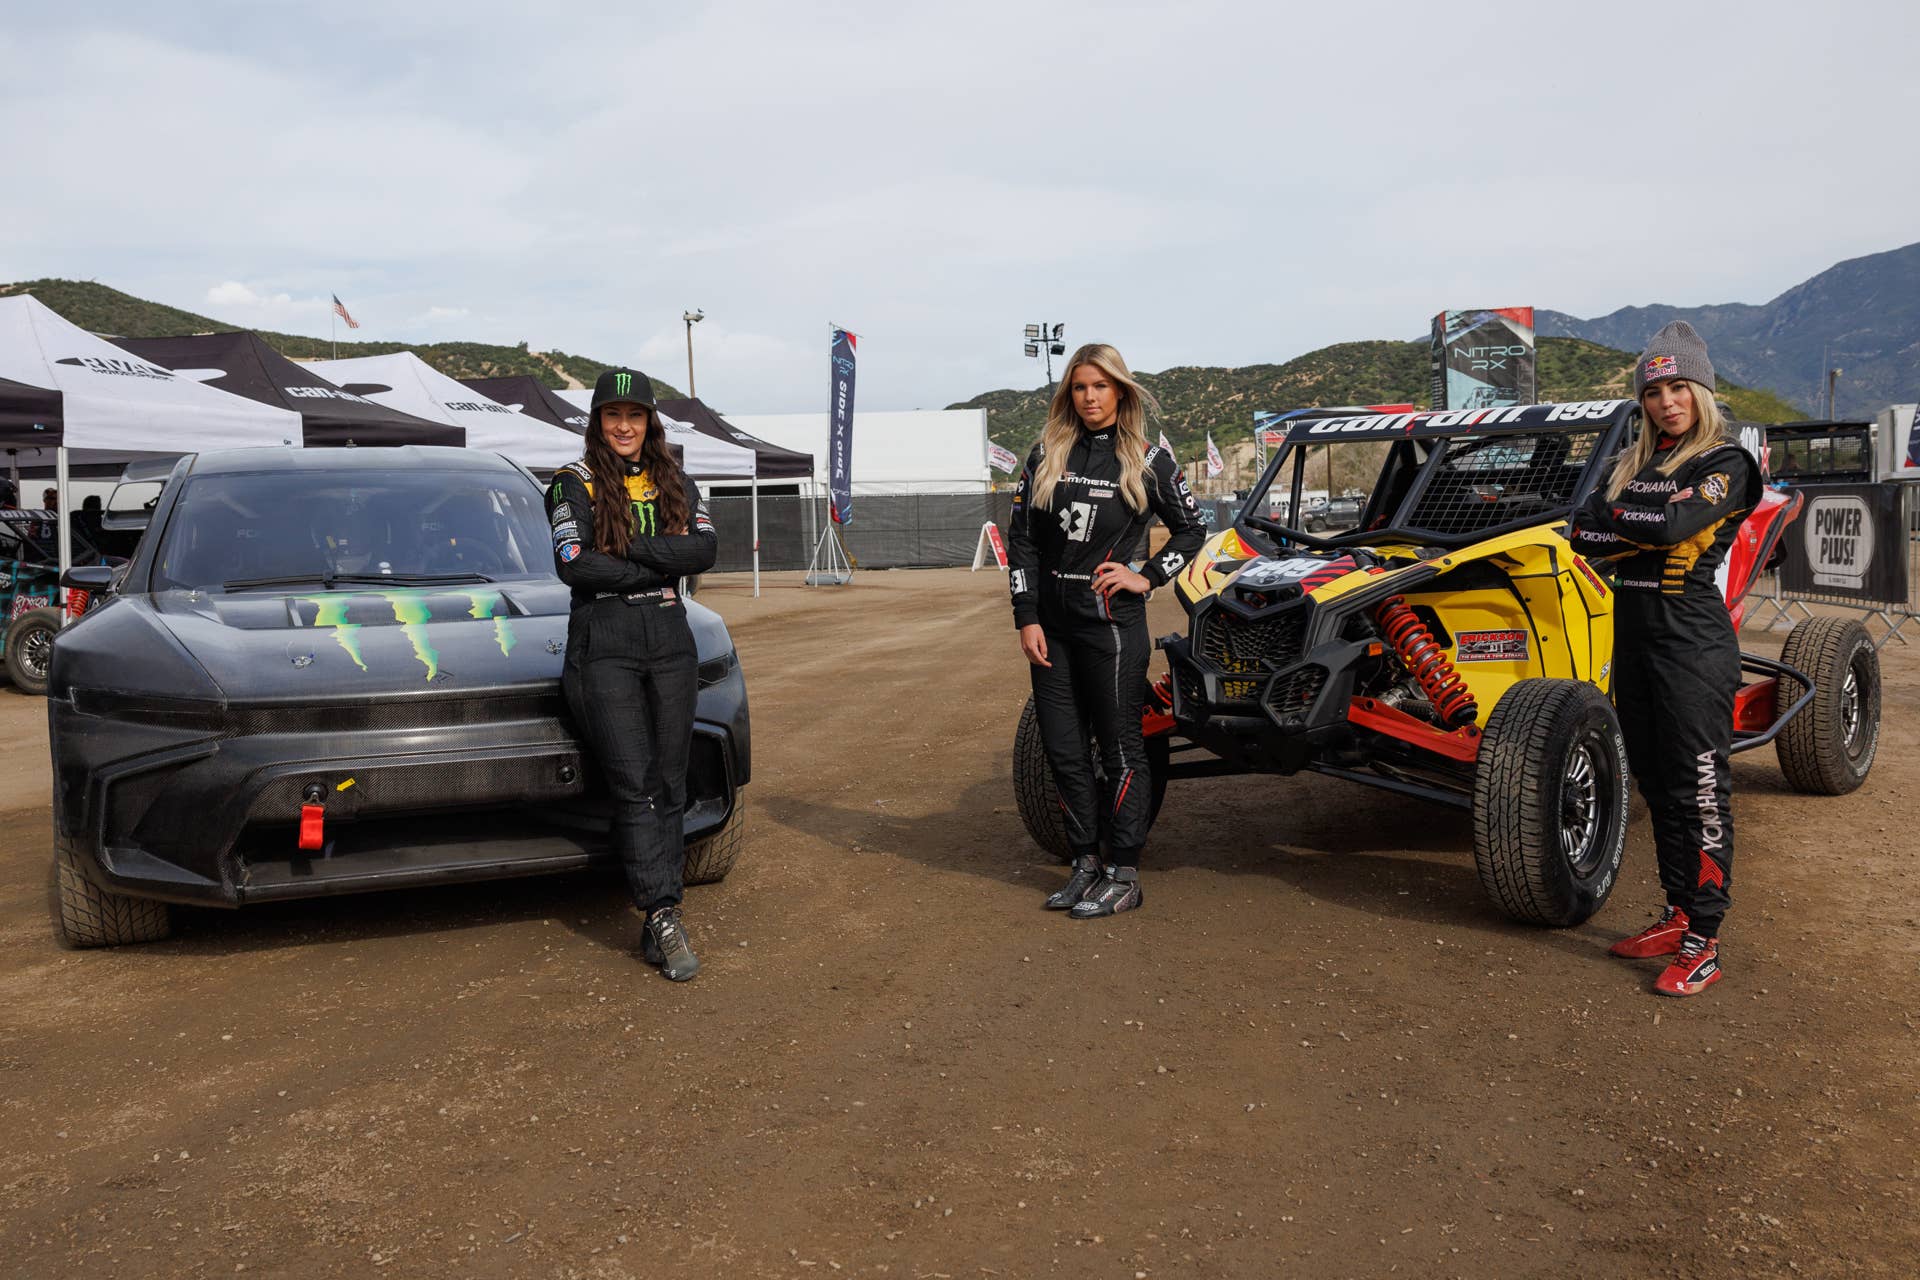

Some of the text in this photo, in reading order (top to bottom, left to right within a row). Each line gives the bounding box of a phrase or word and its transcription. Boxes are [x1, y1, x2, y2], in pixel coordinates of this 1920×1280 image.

[1453, 345, 1526, 358] NITRO
[1471, 359, 1507, 370] RX
[1645, 365, 1678, 380] Red Bull
[838, 380, 847, 422] SIDE
[1308, 399, 1629, 434] can-am 199
[836, 424, 844, 437] X
[836, 440, 844, 479] SIDE
[1186, 495, 1195, 509] 9
[1623, 509, 1666, 522] YOKOHAMA
[1815, 508, 1862, 536] POWER
[1819, 537, 1855, 566] PLUS!
[1459, 632, 1525, 645] ERICKSON
[1697, 749, 1722, 850] YOKOHAMA
